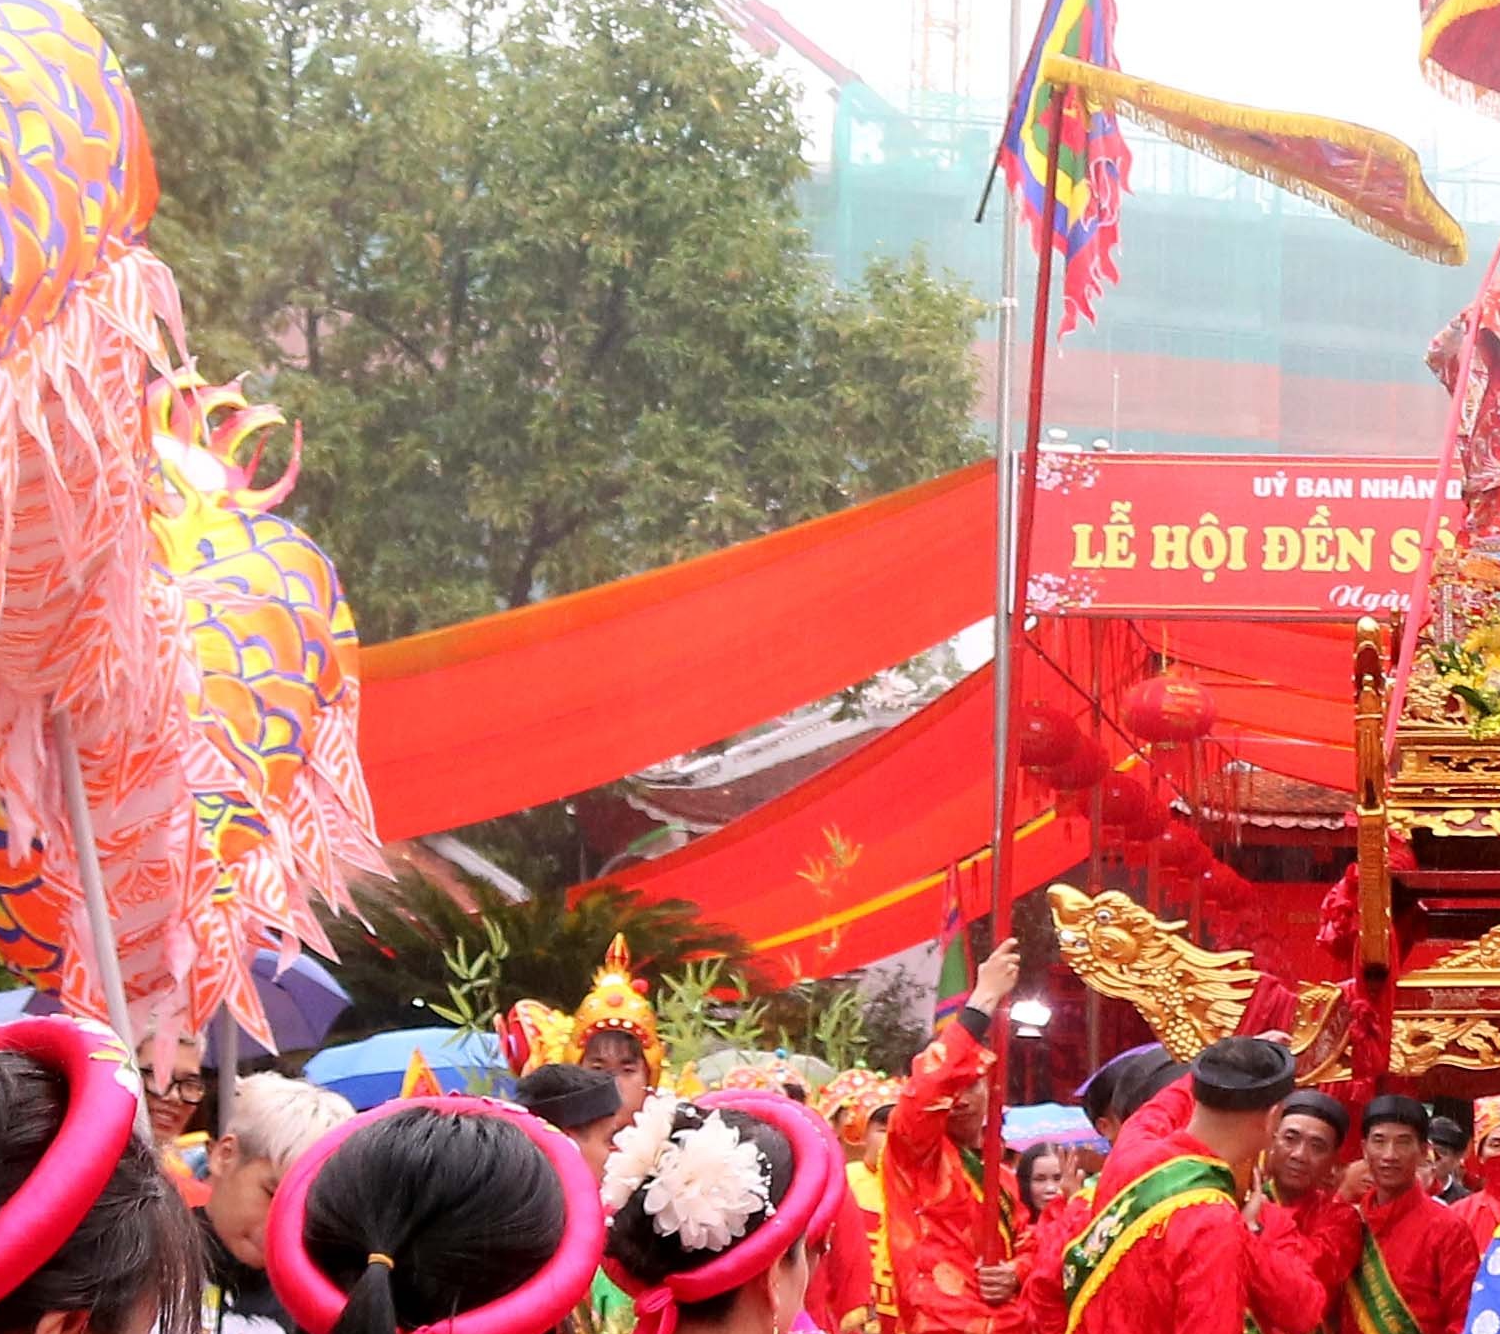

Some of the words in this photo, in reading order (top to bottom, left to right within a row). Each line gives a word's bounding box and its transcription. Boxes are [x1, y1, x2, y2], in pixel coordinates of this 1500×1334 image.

[1253, 471, 1288, 498] UỶ
[1296, 476, 1353, 499] BAN
[1360, 474, 1436, 499] NHÂN
[1071, 500, 1136, 570] LỄ
[1150, 513, 1248, 583] HỘI
[1263, 505, 1375, 571] ĐỀN
